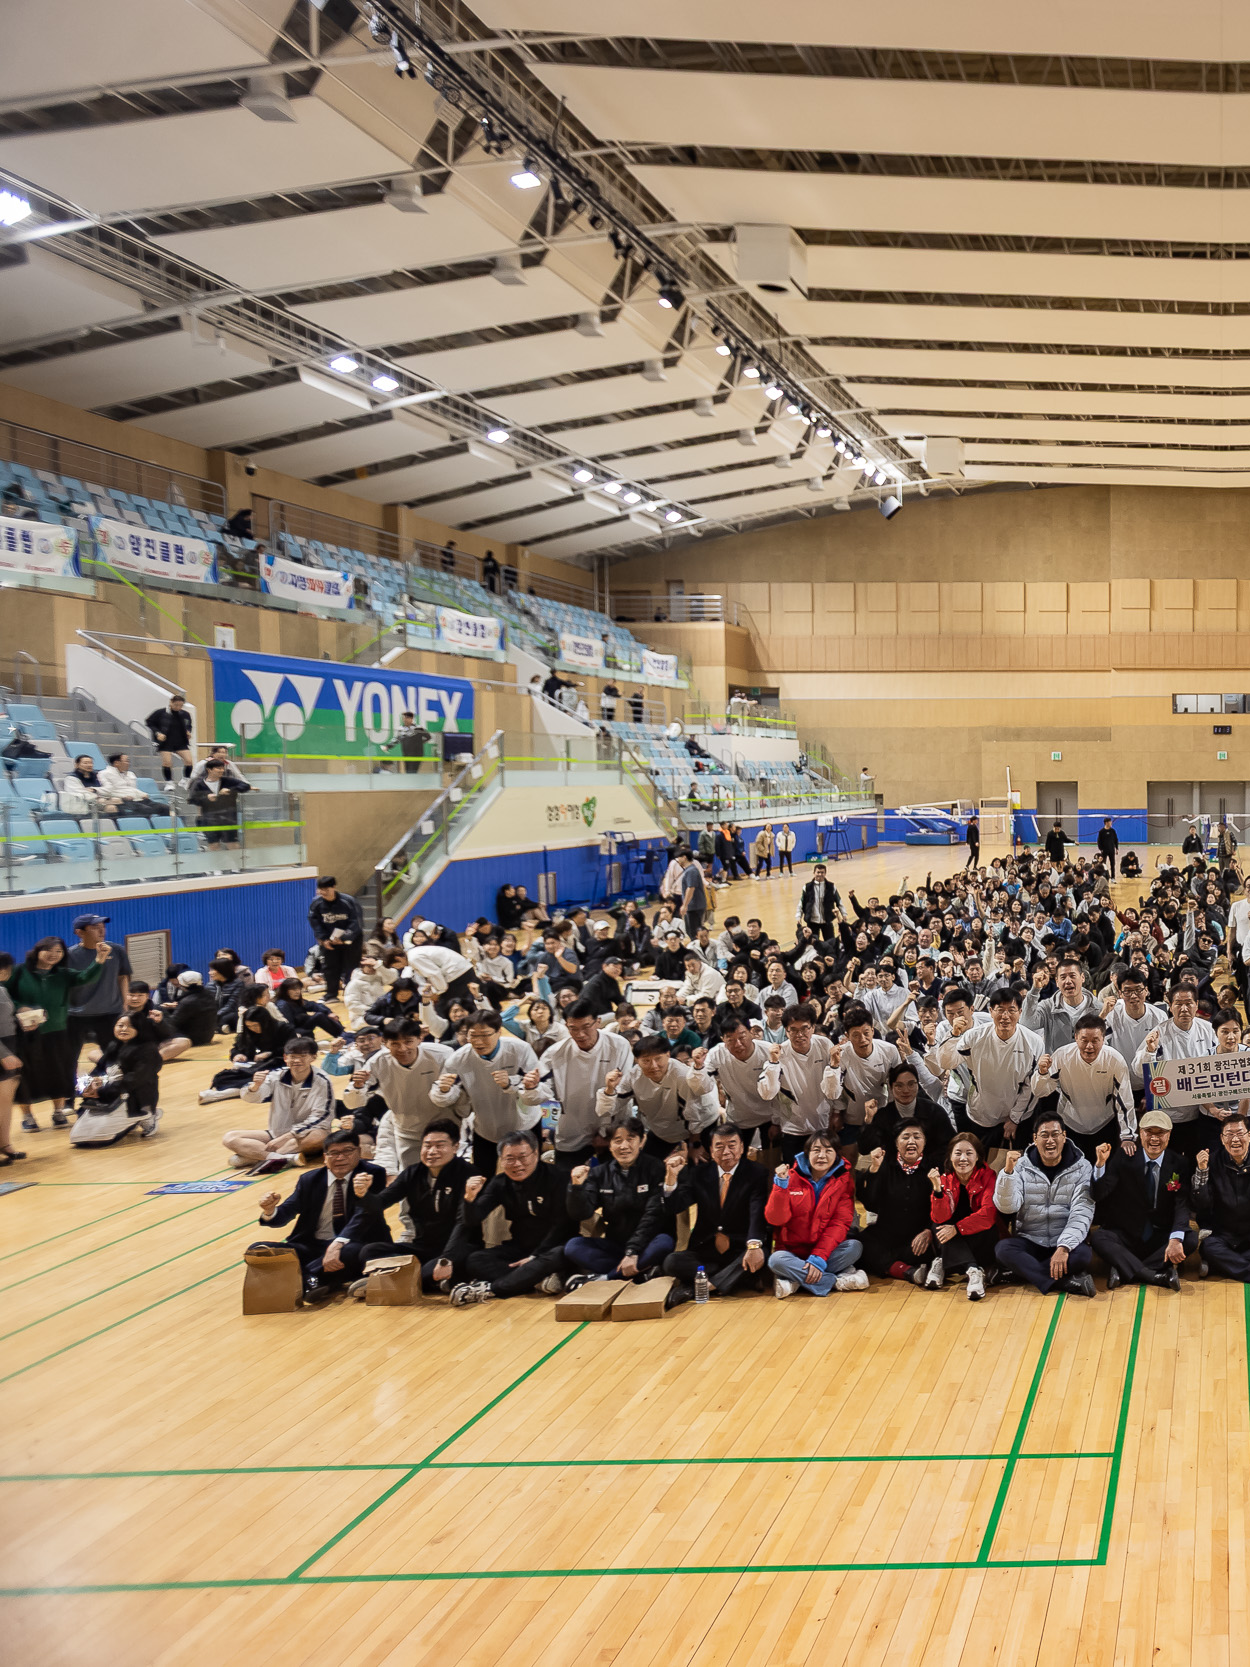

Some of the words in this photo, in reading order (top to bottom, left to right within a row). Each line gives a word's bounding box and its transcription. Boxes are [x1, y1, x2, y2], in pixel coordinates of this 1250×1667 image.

[128, 533, 185, 565] 양진클럽
[332, 678, 463, 744] YONEX
[1177, 1061, 1211, 1075] 제31회
[1152, 1078, 1167, 1094] 필
